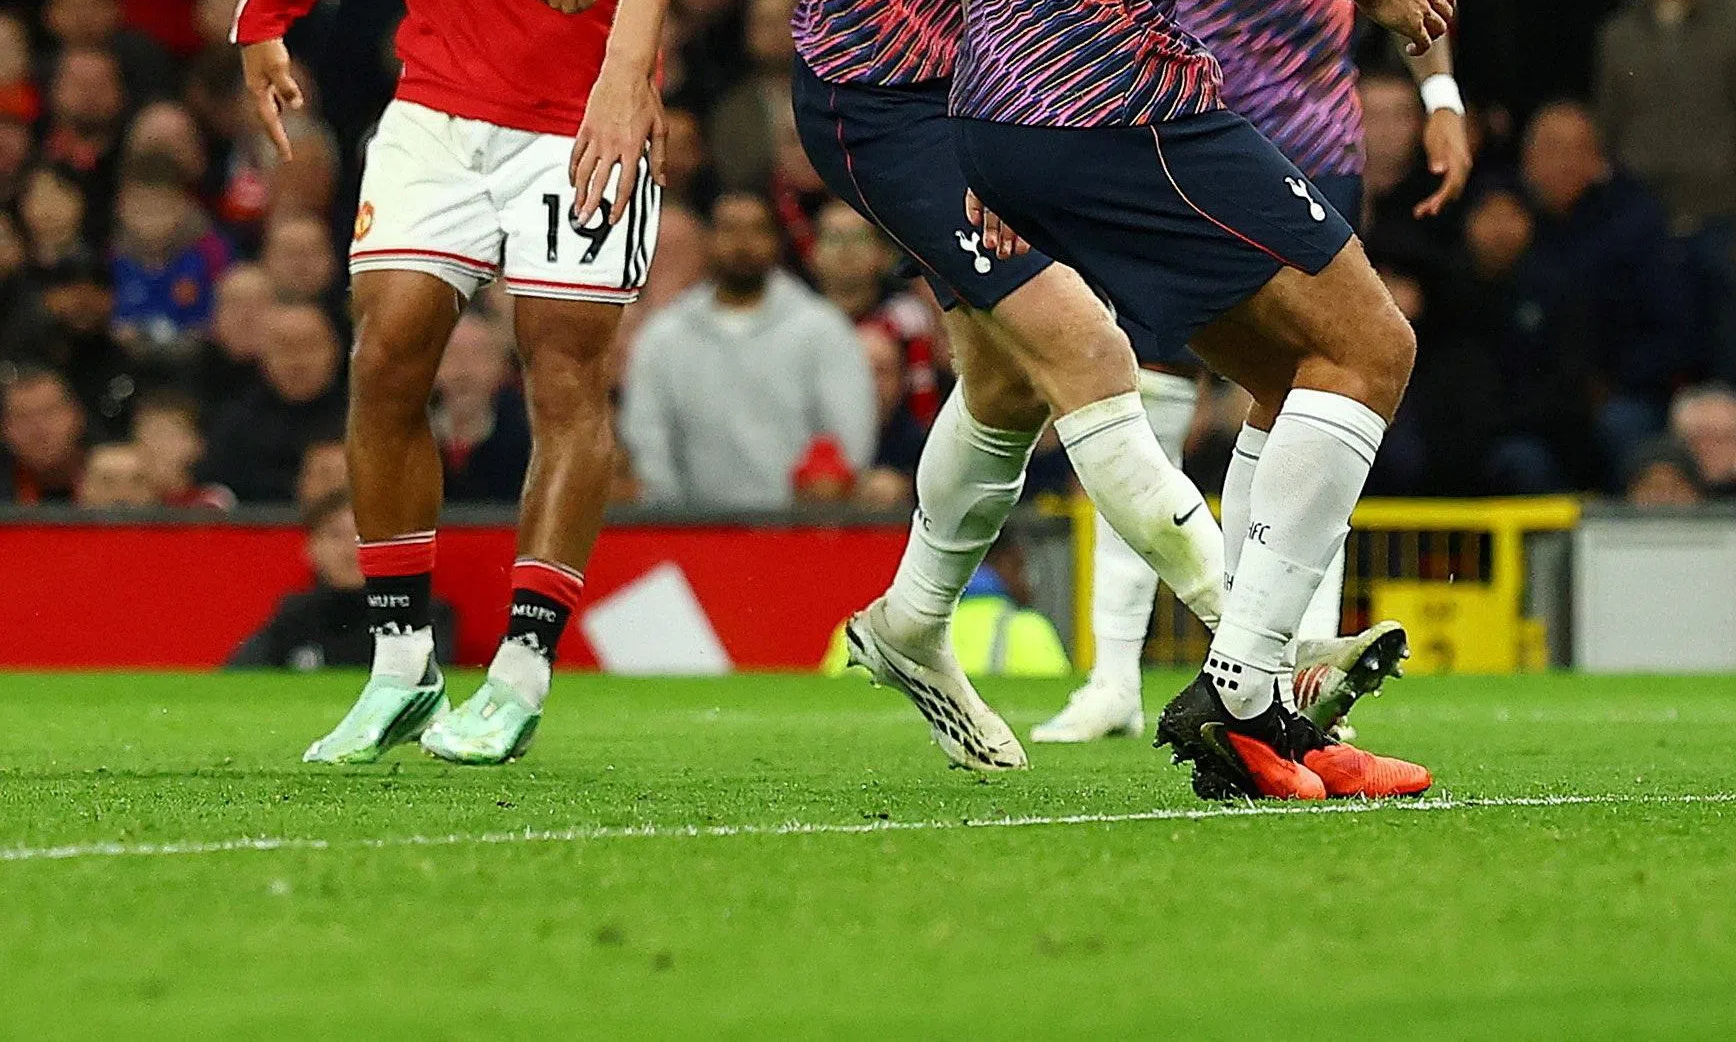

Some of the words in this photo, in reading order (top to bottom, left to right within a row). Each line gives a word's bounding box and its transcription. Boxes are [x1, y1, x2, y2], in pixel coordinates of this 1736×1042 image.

[542, 194, 613, 264] 19
[366, 593, 411, 608] MUFC
[510, 601, 557, 623] MUFC
